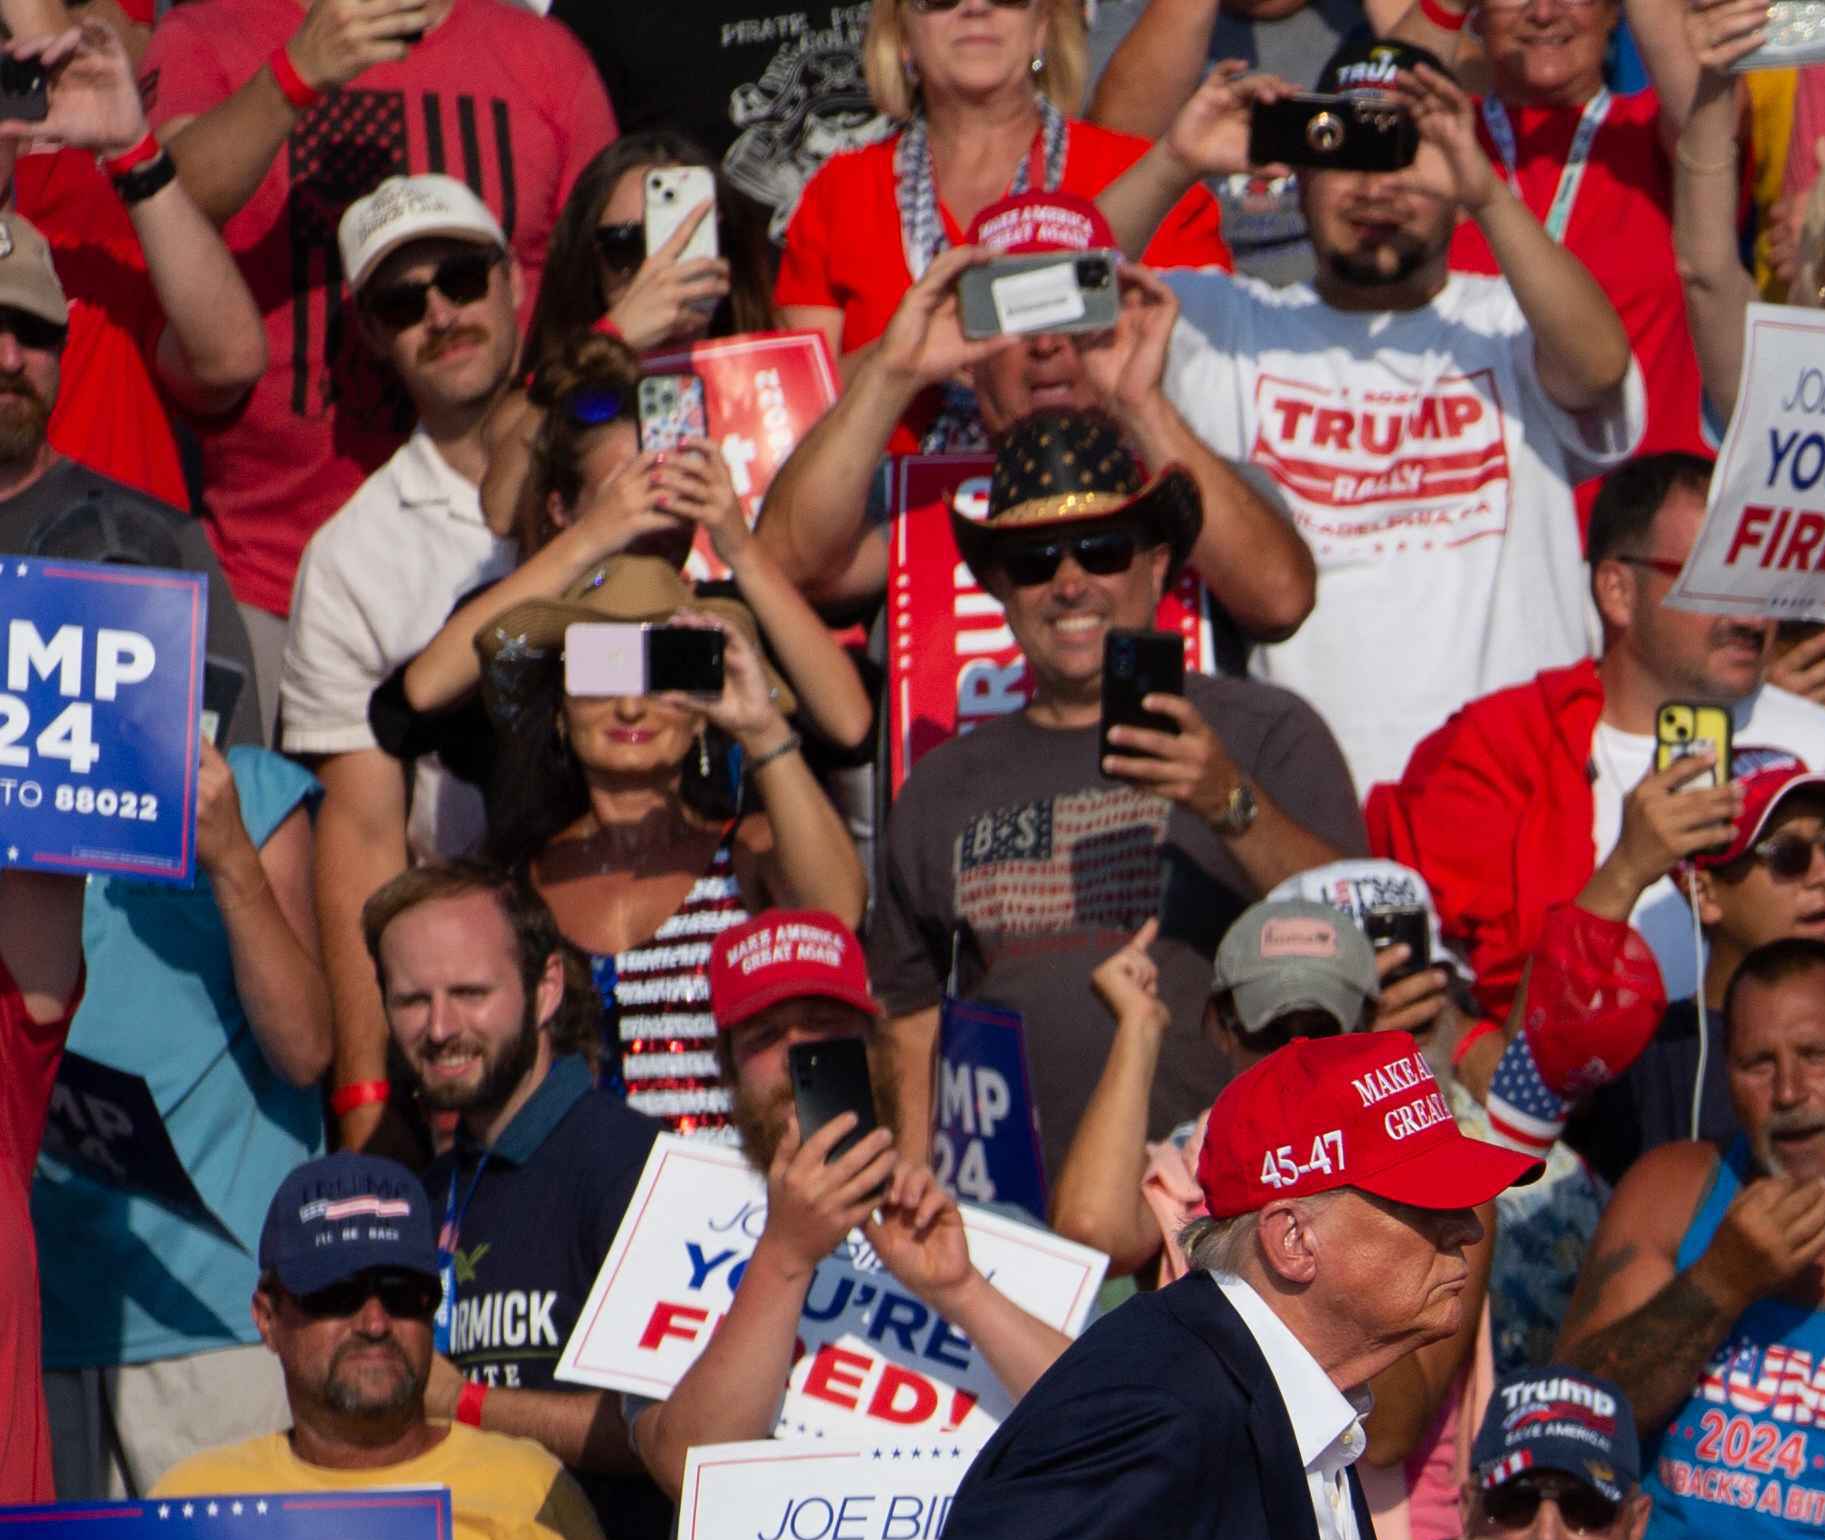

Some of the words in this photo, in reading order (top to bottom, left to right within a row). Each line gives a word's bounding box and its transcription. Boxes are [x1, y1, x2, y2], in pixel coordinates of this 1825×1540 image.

[1274, 394, 1482, 457] TRUMP
[1332, 466, 1424, 502] RALLY
[55, 783, 158, 822] 88022
[726, 928, 771, 968] MAKE
[776, 923, 845, 950] AMERICA
[742, 942, 792, 976] GREAT
[796, 942, 842, 967] AGAIN
[1352, 1056, 1415, 1108] MAKE
[1260, 1129, 1347, 1189] 45-47
[450, 1289, 559, 1355] RMICK
[638, 1300, 979, 1433] FED!
[1502, 1377, 1616, 1417] Trump
[1697, 1409, 1808, 1479] 2024
[1756, 1483, 1782, 1515] A
